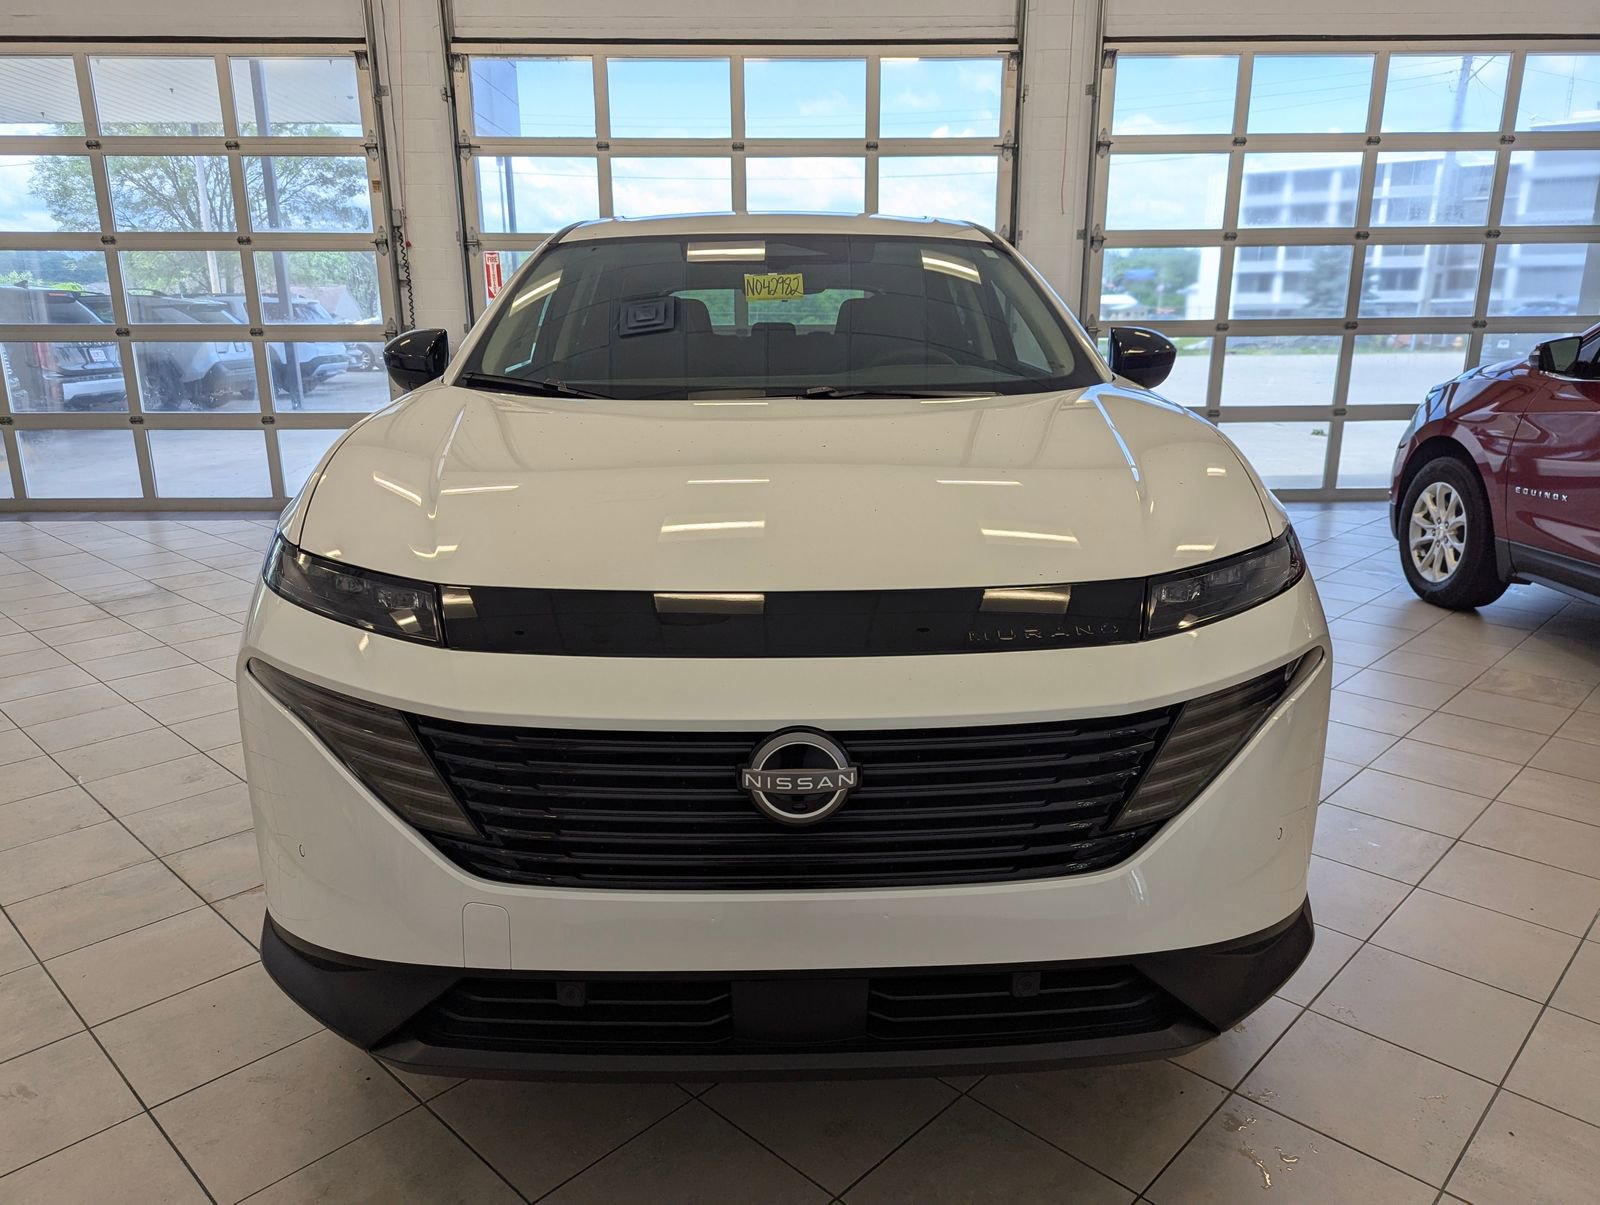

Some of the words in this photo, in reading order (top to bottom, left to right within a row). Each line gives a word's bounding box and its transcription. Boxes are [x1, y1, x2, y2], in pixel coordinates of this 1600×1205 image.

[1515, 486, 1568, 502] EQUINOX
[968, 623, 1120, 641] MURANO
[745, 772, 854, 790] NISSAN
